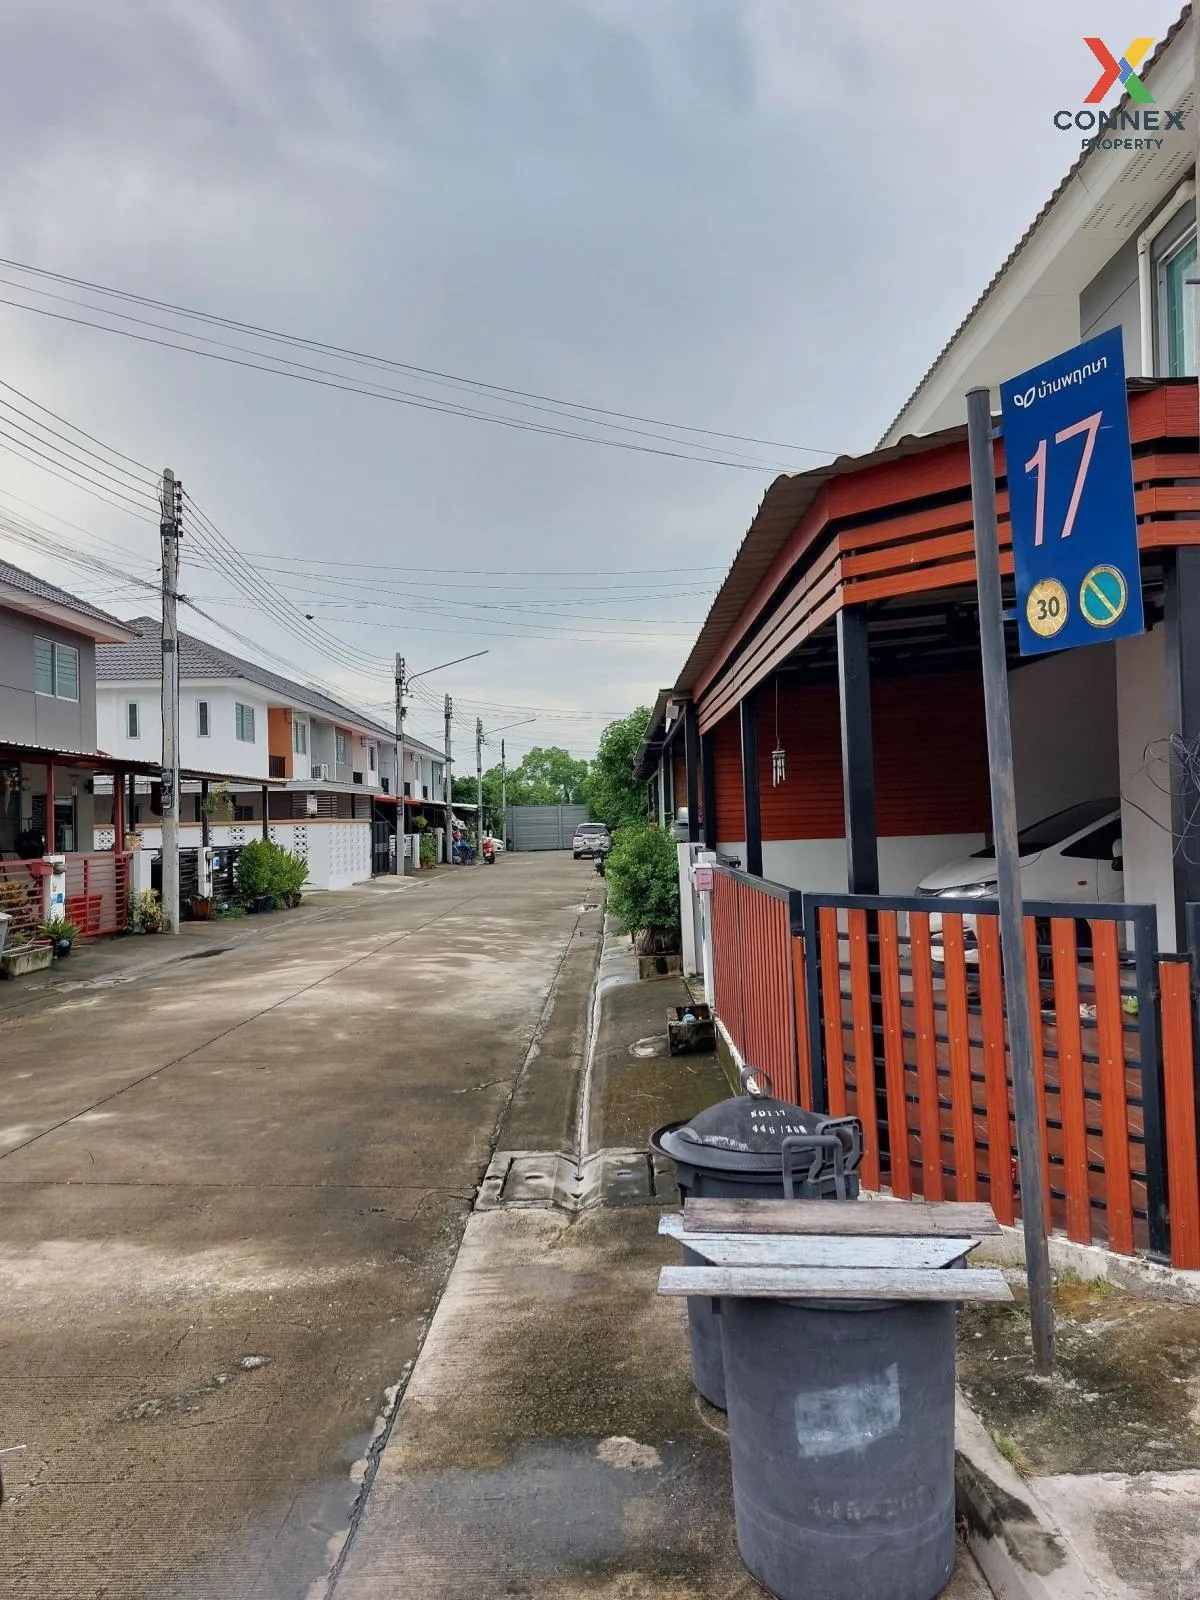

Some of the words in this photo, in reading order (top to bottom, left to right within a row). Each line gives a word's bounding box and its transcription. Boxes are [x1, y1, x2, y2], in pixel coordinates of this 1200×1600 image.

[1037, 355, 1108, 399] บ้านพฤกษา
[1024, 410, 1104, 547] 17
[1036, 594, 1061, 621] 30
